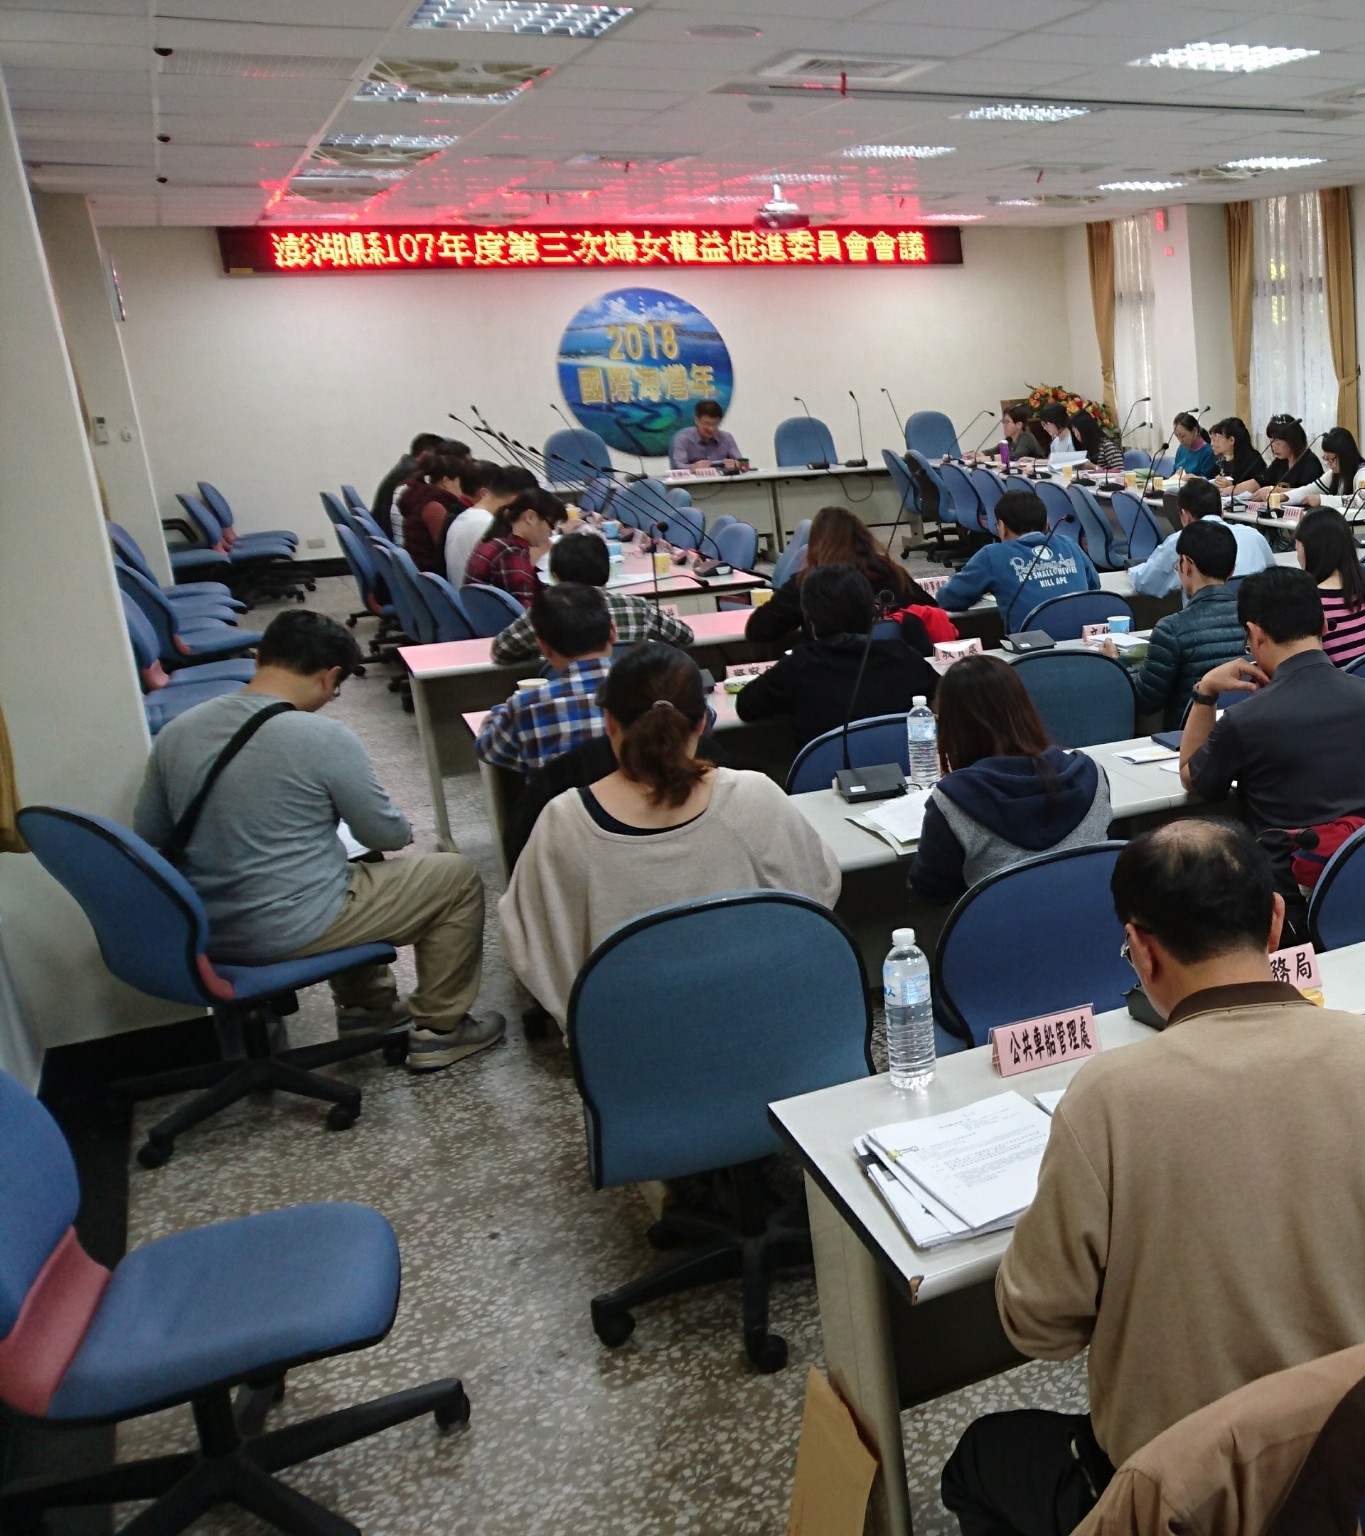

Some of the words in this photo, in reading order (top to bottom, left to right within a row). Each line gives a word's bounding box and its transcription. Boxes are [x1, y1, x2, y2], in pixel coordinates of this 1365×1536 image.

[271, 230, 927, 267] 澎湖縣107年度第三次婦女權益促進委員會會議
[607, 323, 679, 360] 2018
[1032, 568, 1053, 579] SHALL
[1040, 578, 1055, 587] KILL
[1056, 576, 1068, 585] APE
[1270, 951, 1313, 983] 務局
[1010, 1015, 1092, 1065] 公共車船管理處
